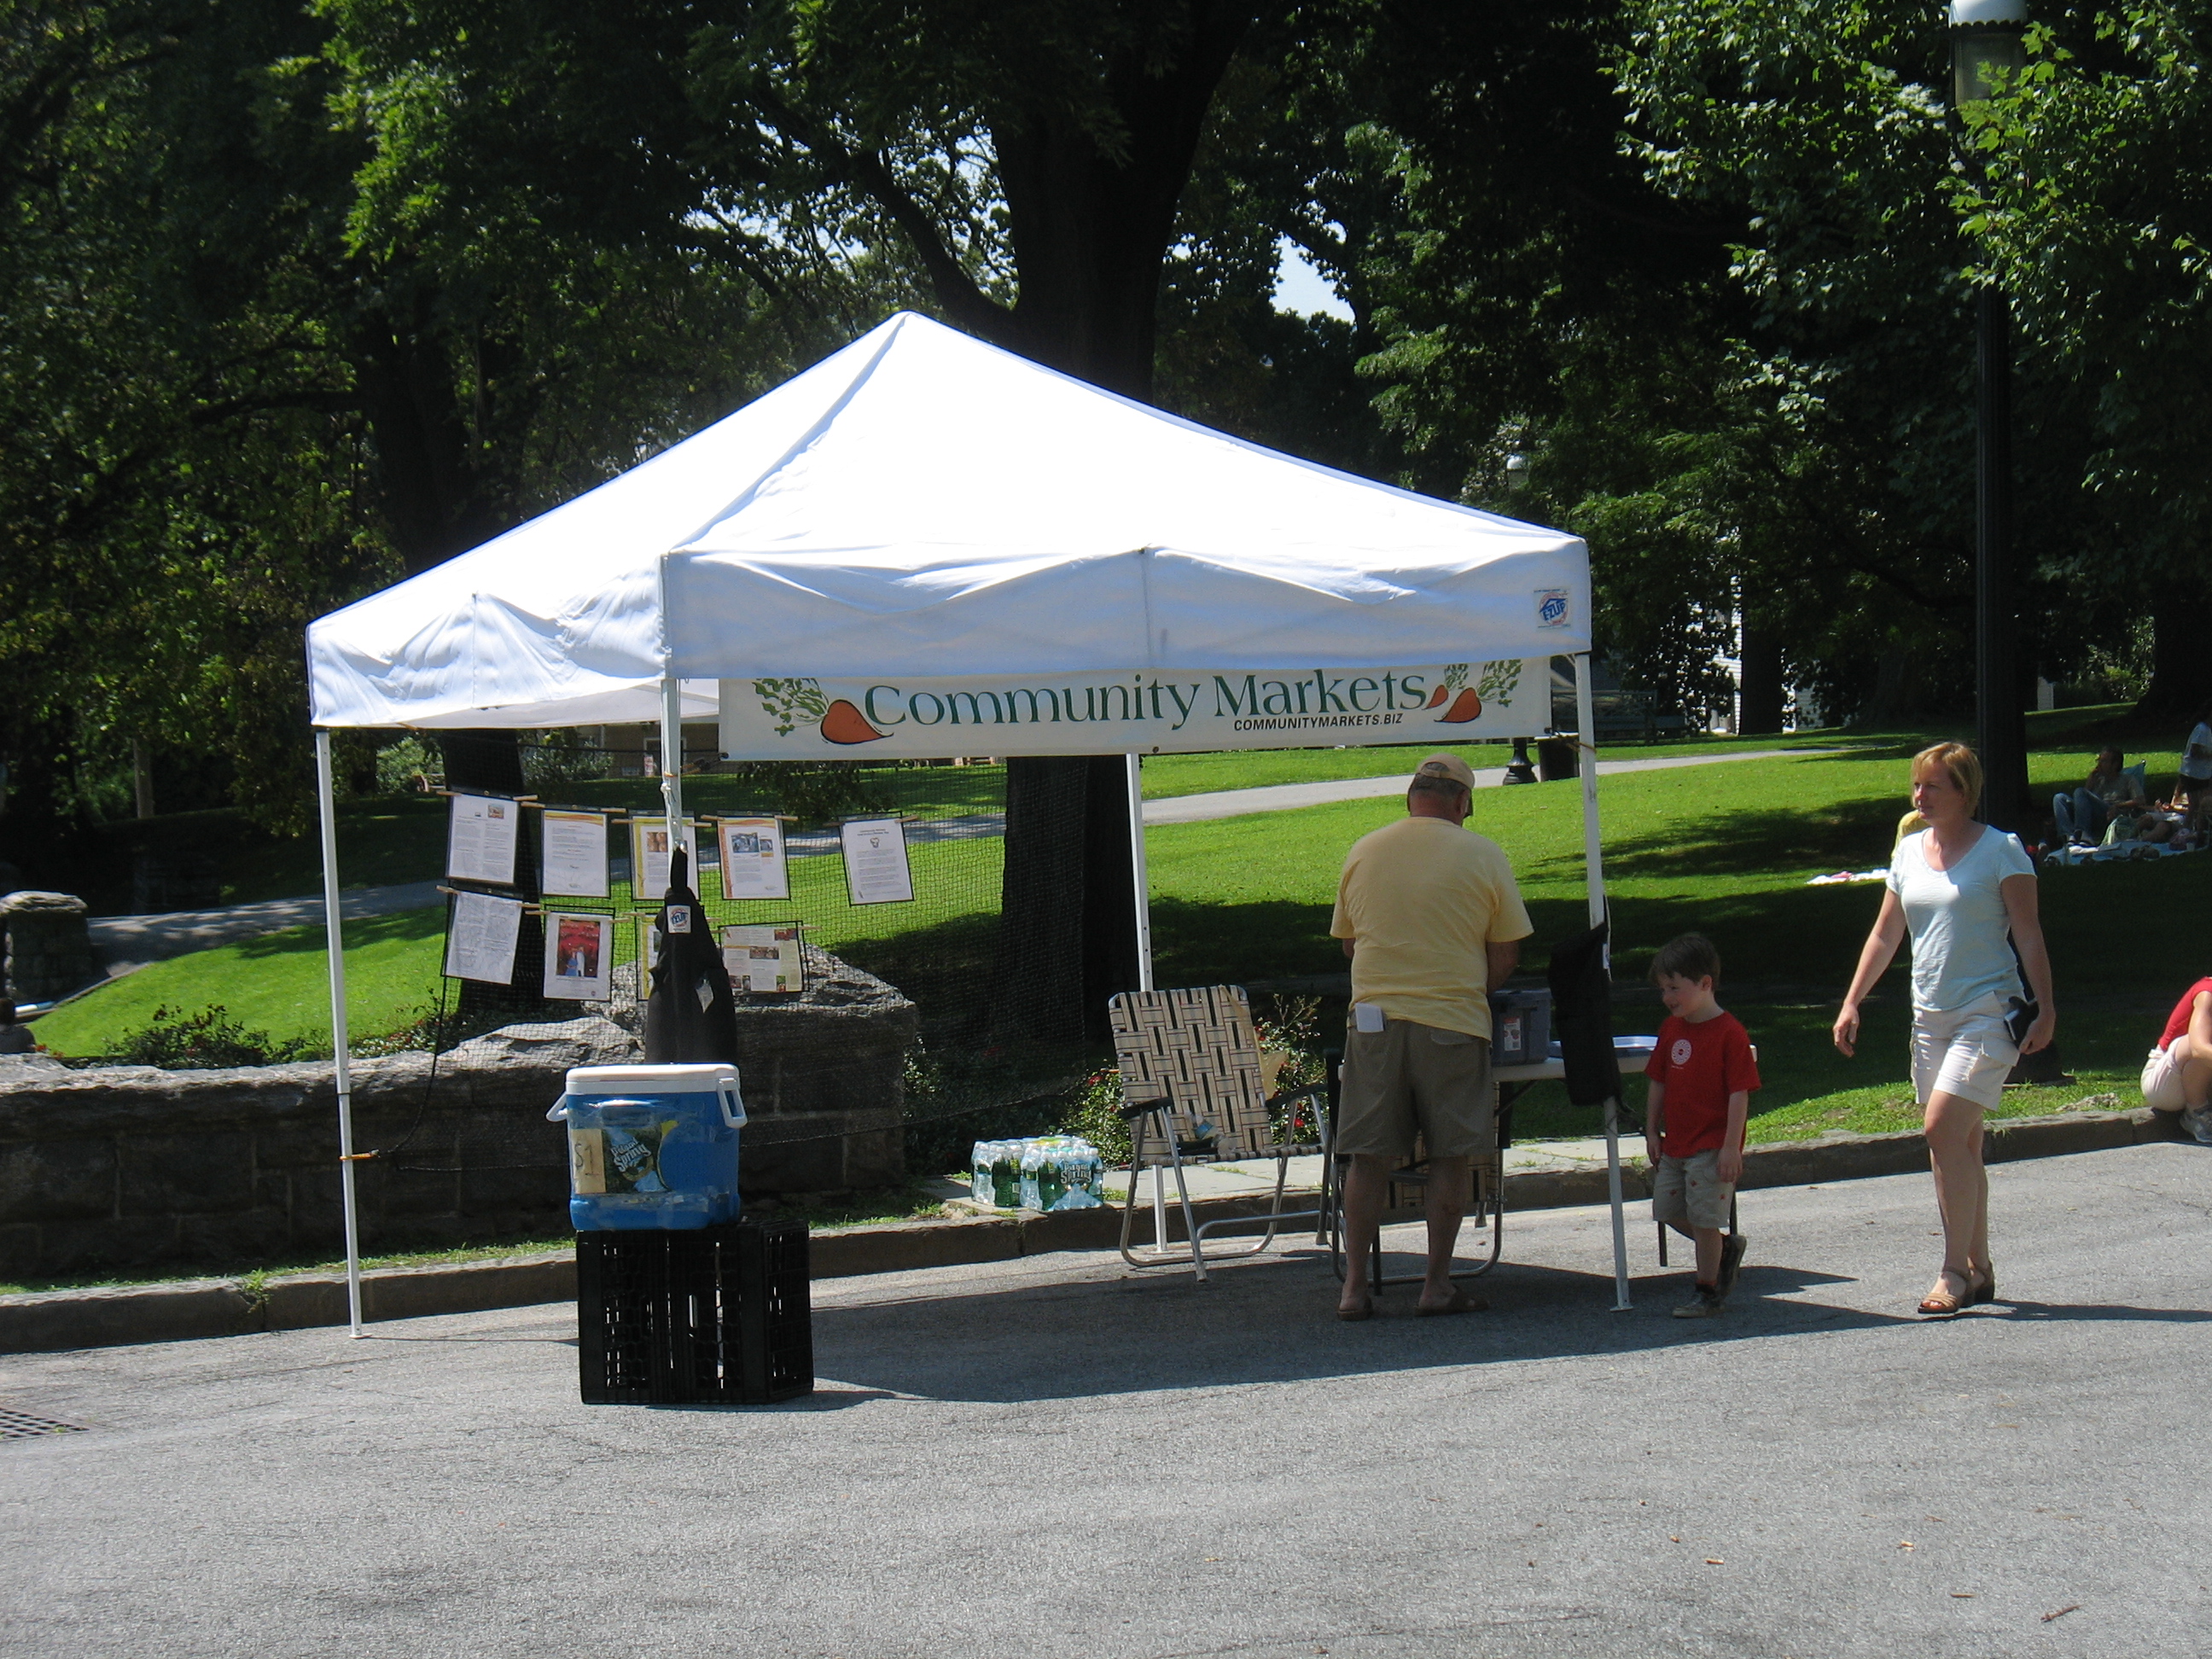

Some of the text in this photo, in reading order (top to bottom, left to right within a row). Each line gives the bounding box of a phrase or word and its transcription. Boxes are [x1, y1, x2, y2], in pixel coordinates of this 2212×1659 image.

[864, 669, 1427, 731] Community Markets
[1233, 713, 1404, 731] COMMUNITYMARKETS.BIZ
[614, 1144, 651, 1173] Spring
[1060, 1169, 1092, 1184] Spring
